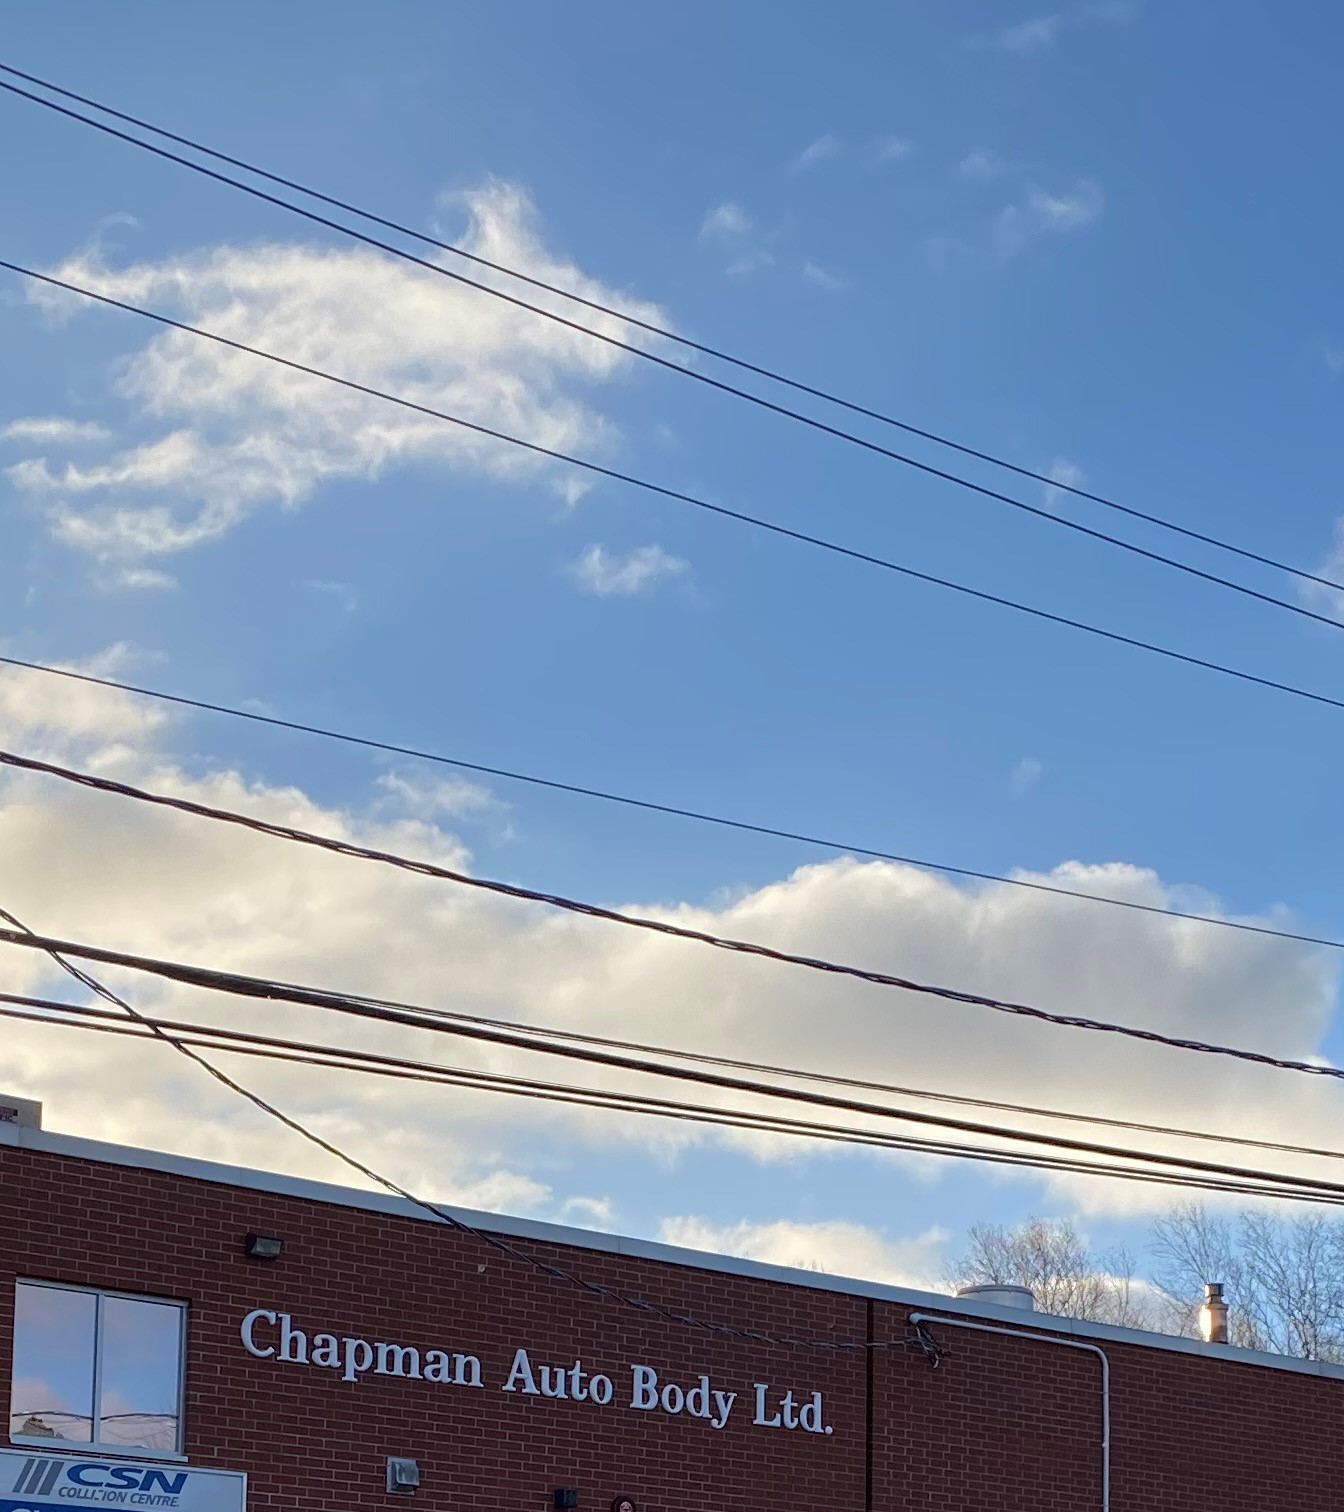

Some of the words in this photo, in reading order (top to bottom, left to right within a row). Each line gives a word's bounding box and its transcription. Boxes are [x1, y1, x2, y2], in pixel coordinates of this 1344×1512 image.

[239, 1307, 484, 1388] Chapman
[502, 1347, 614, 1406] Auto
[629, 1364, 738, 1430] Body
[752, 1382, 835, 1435] Ltd.
[66, 1463, 189, 1495] CSN
[130, 1492, 180, 1508] CENTRE
